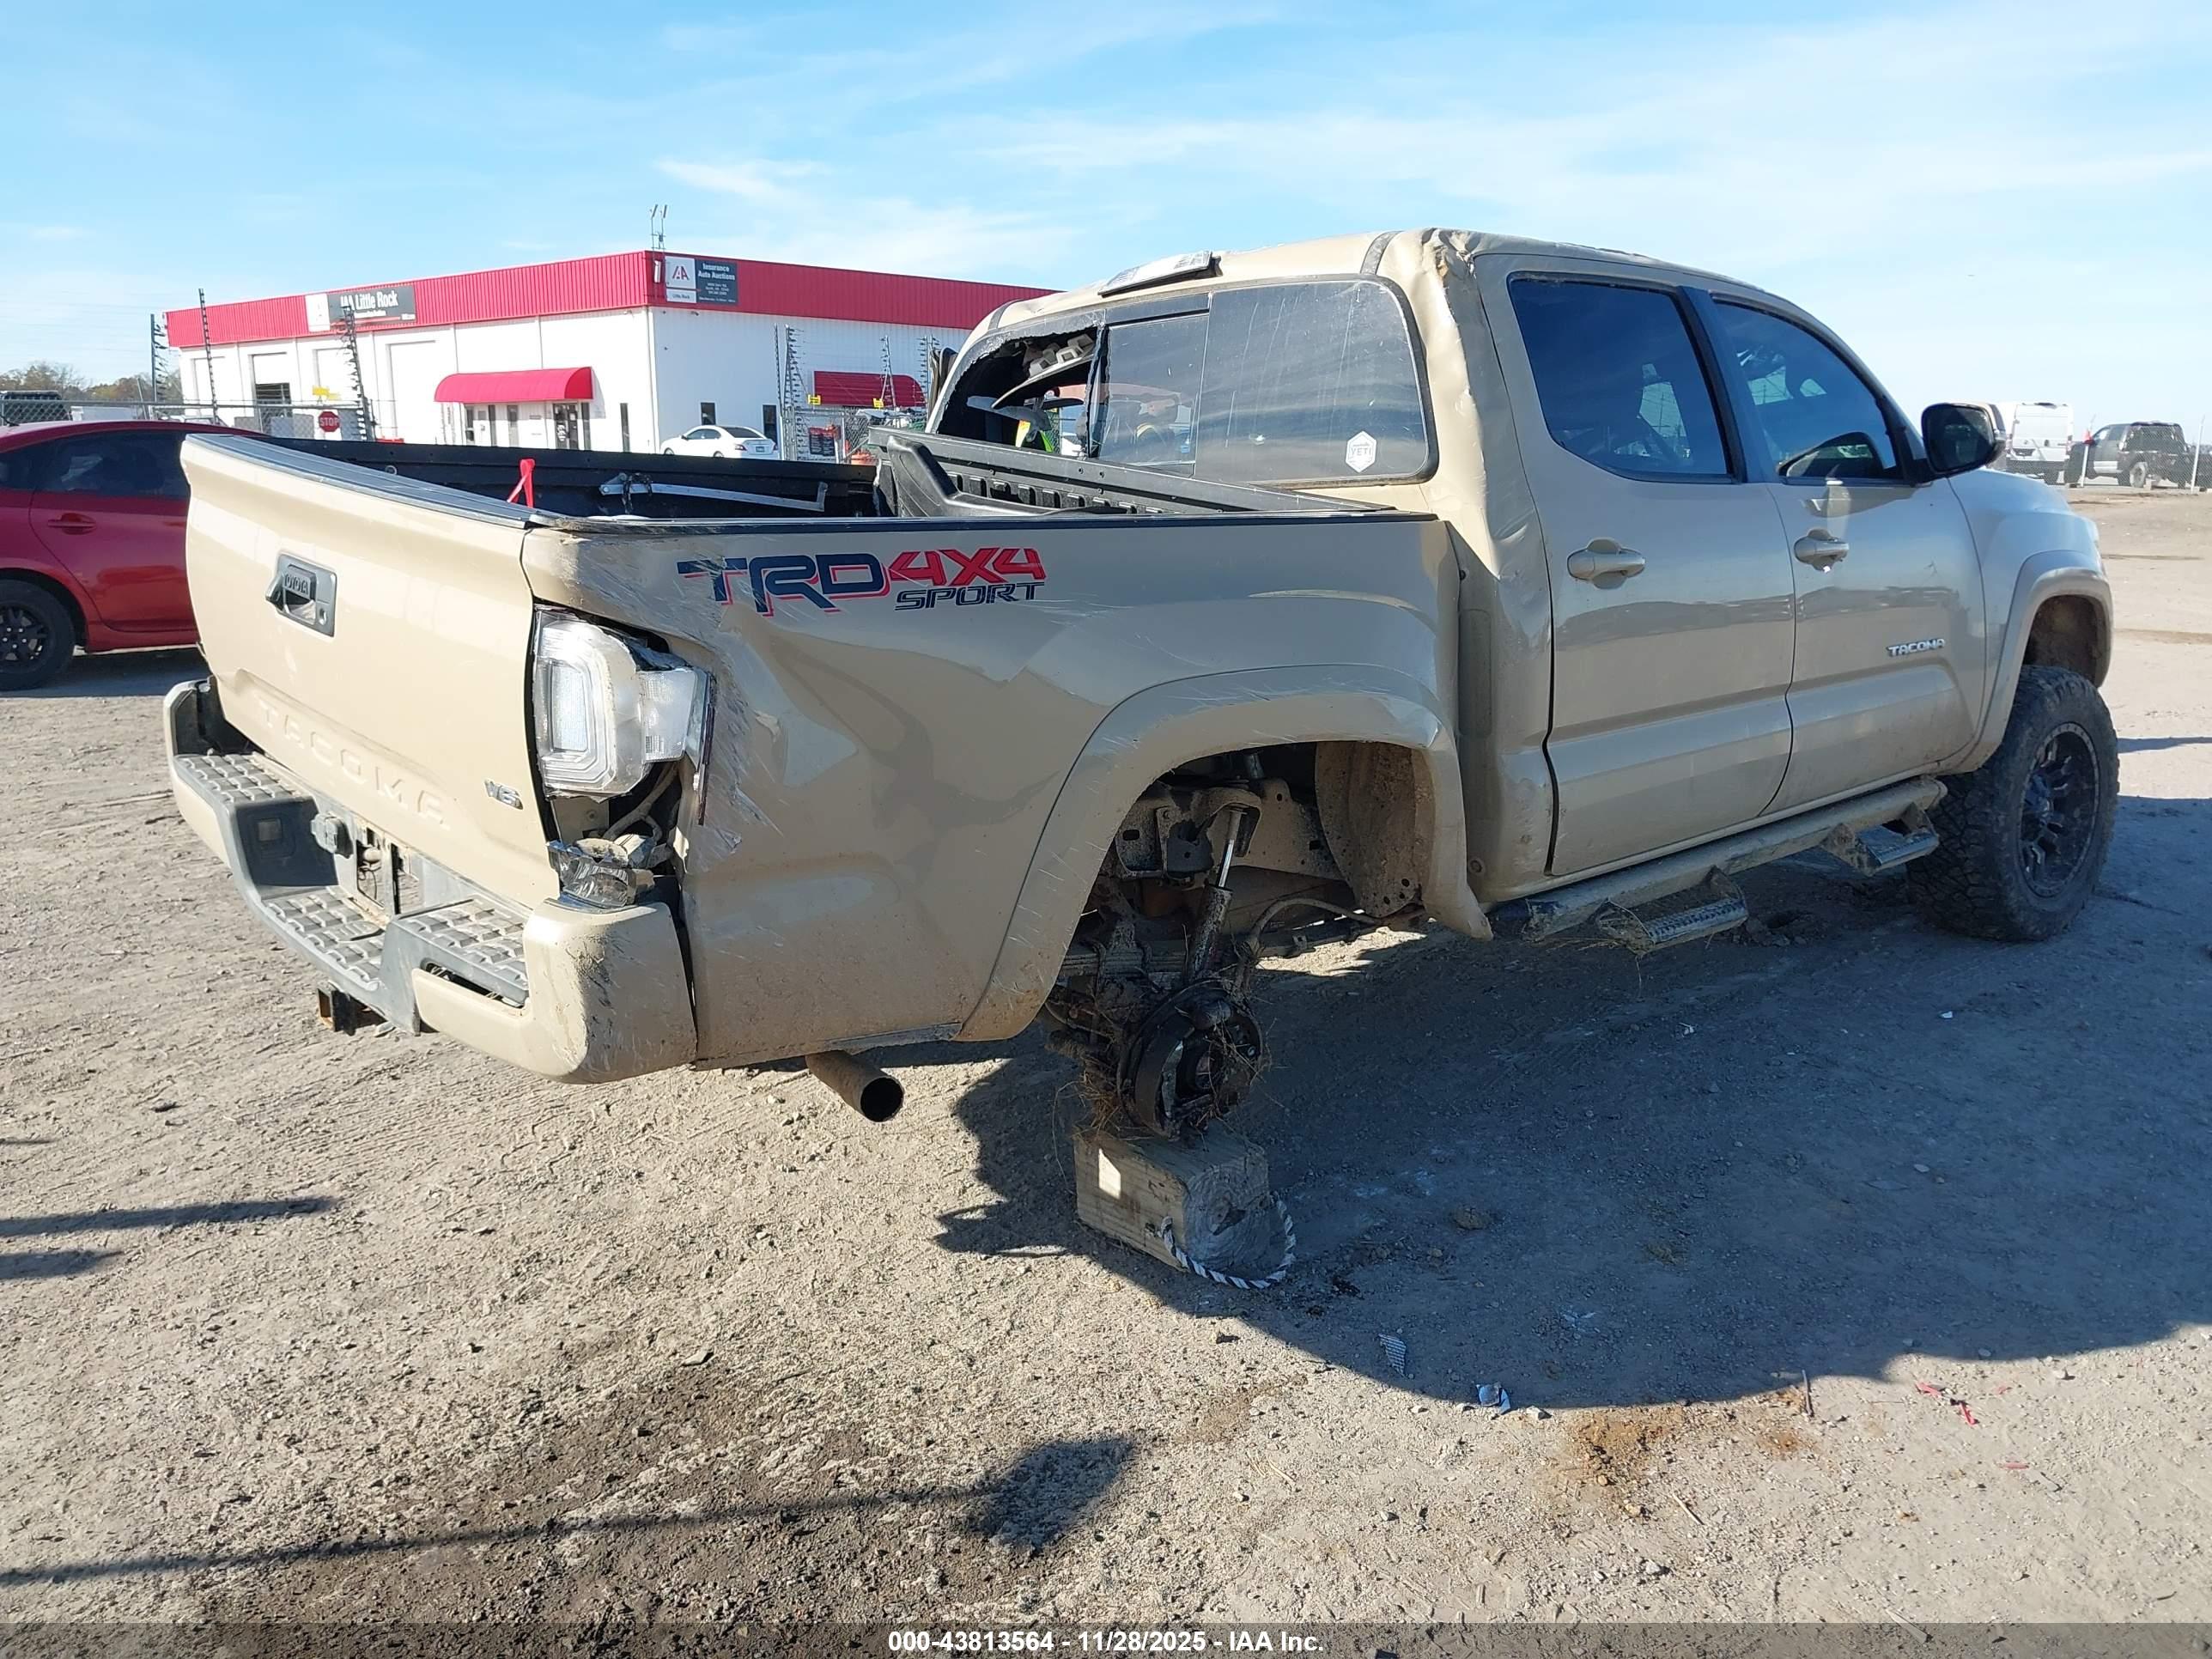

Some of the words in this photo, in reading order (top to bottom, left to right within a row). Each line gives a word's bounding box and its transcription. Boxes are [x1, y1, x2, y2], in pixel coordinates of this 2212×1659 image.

[697, 270, 711, 278] Auto
[711, 271, 736, 281] Auctions
[702, 263, 730, 272] Insurance
[356, 293, 376, 310] Little
[376, 290, 398, 307] Rock
[319, 417, 340, 427] STOP
[1351, 447, 1372, 456] YETI
[676, 553, 890, 617] TRD
[895, 581, 1045, 611] SPORT
[1887, 638, 1946, 657] TACOMA
[258, 697, 451, 830] TACOMA
[483, 779, 523, 810] V6
